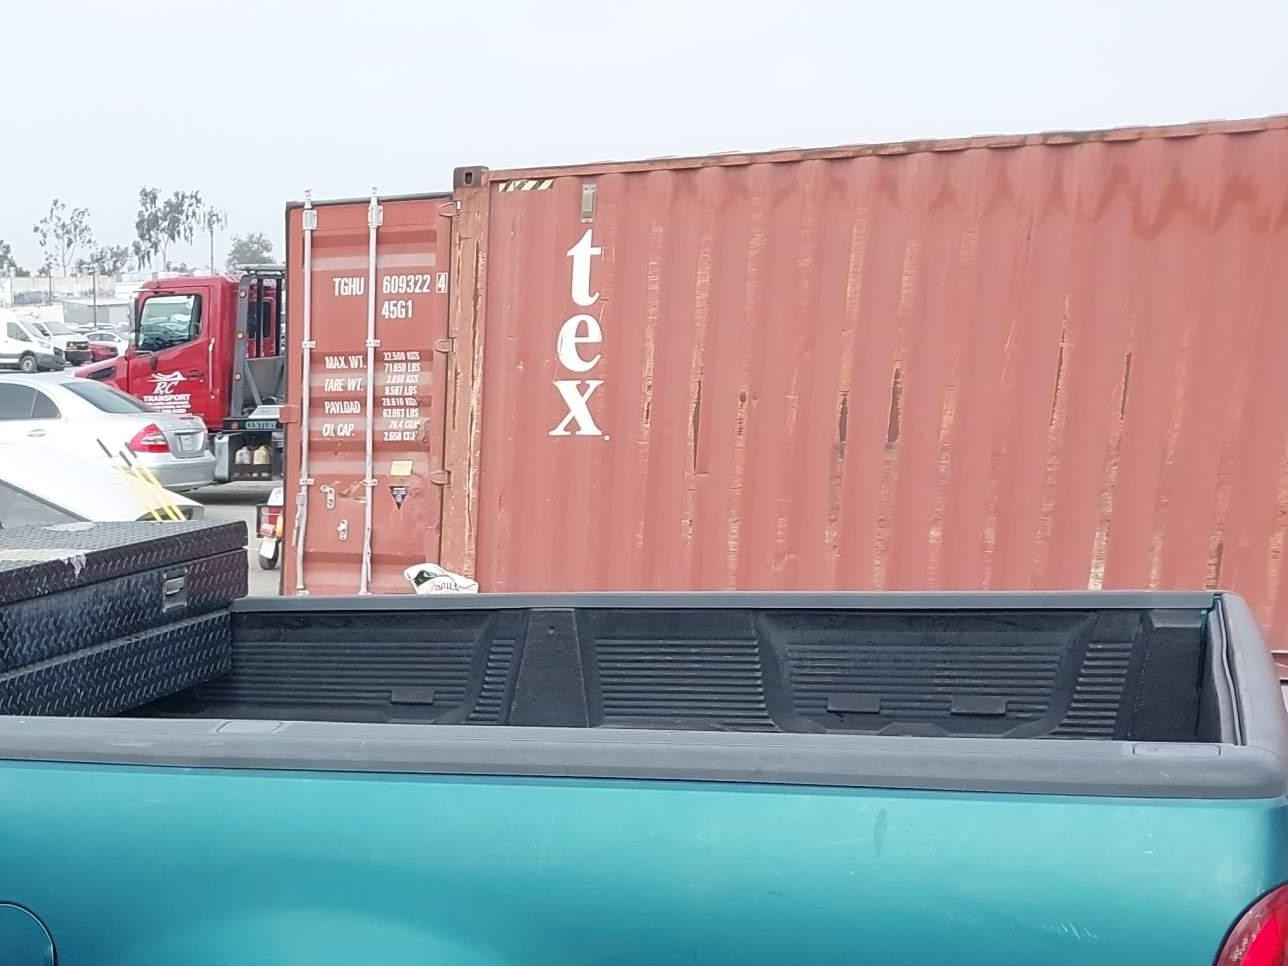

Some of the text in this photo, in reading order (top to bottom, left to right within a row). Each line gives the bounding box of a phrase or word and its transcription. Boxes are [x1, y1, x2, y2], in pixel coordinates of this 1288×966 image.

[332, 273, 447, 296] TGHU 609322 4
[381, 300, 413, 319] 45G1
[324, 355, 367, 369] MAX. WT.
[406, 351, 420, 360] KGS
[407, 363, 421, 372] LBS
[324, 378, 364, 392] TARE WT.
[404, 386, 418, 396] LBS
[142, 394, 191, 402] TRANSPORT
[324, 401, 361, 414] PAYLOAD
[405, 408, 419, 417] LBS
[336, 423, 355, 437] CAP.
